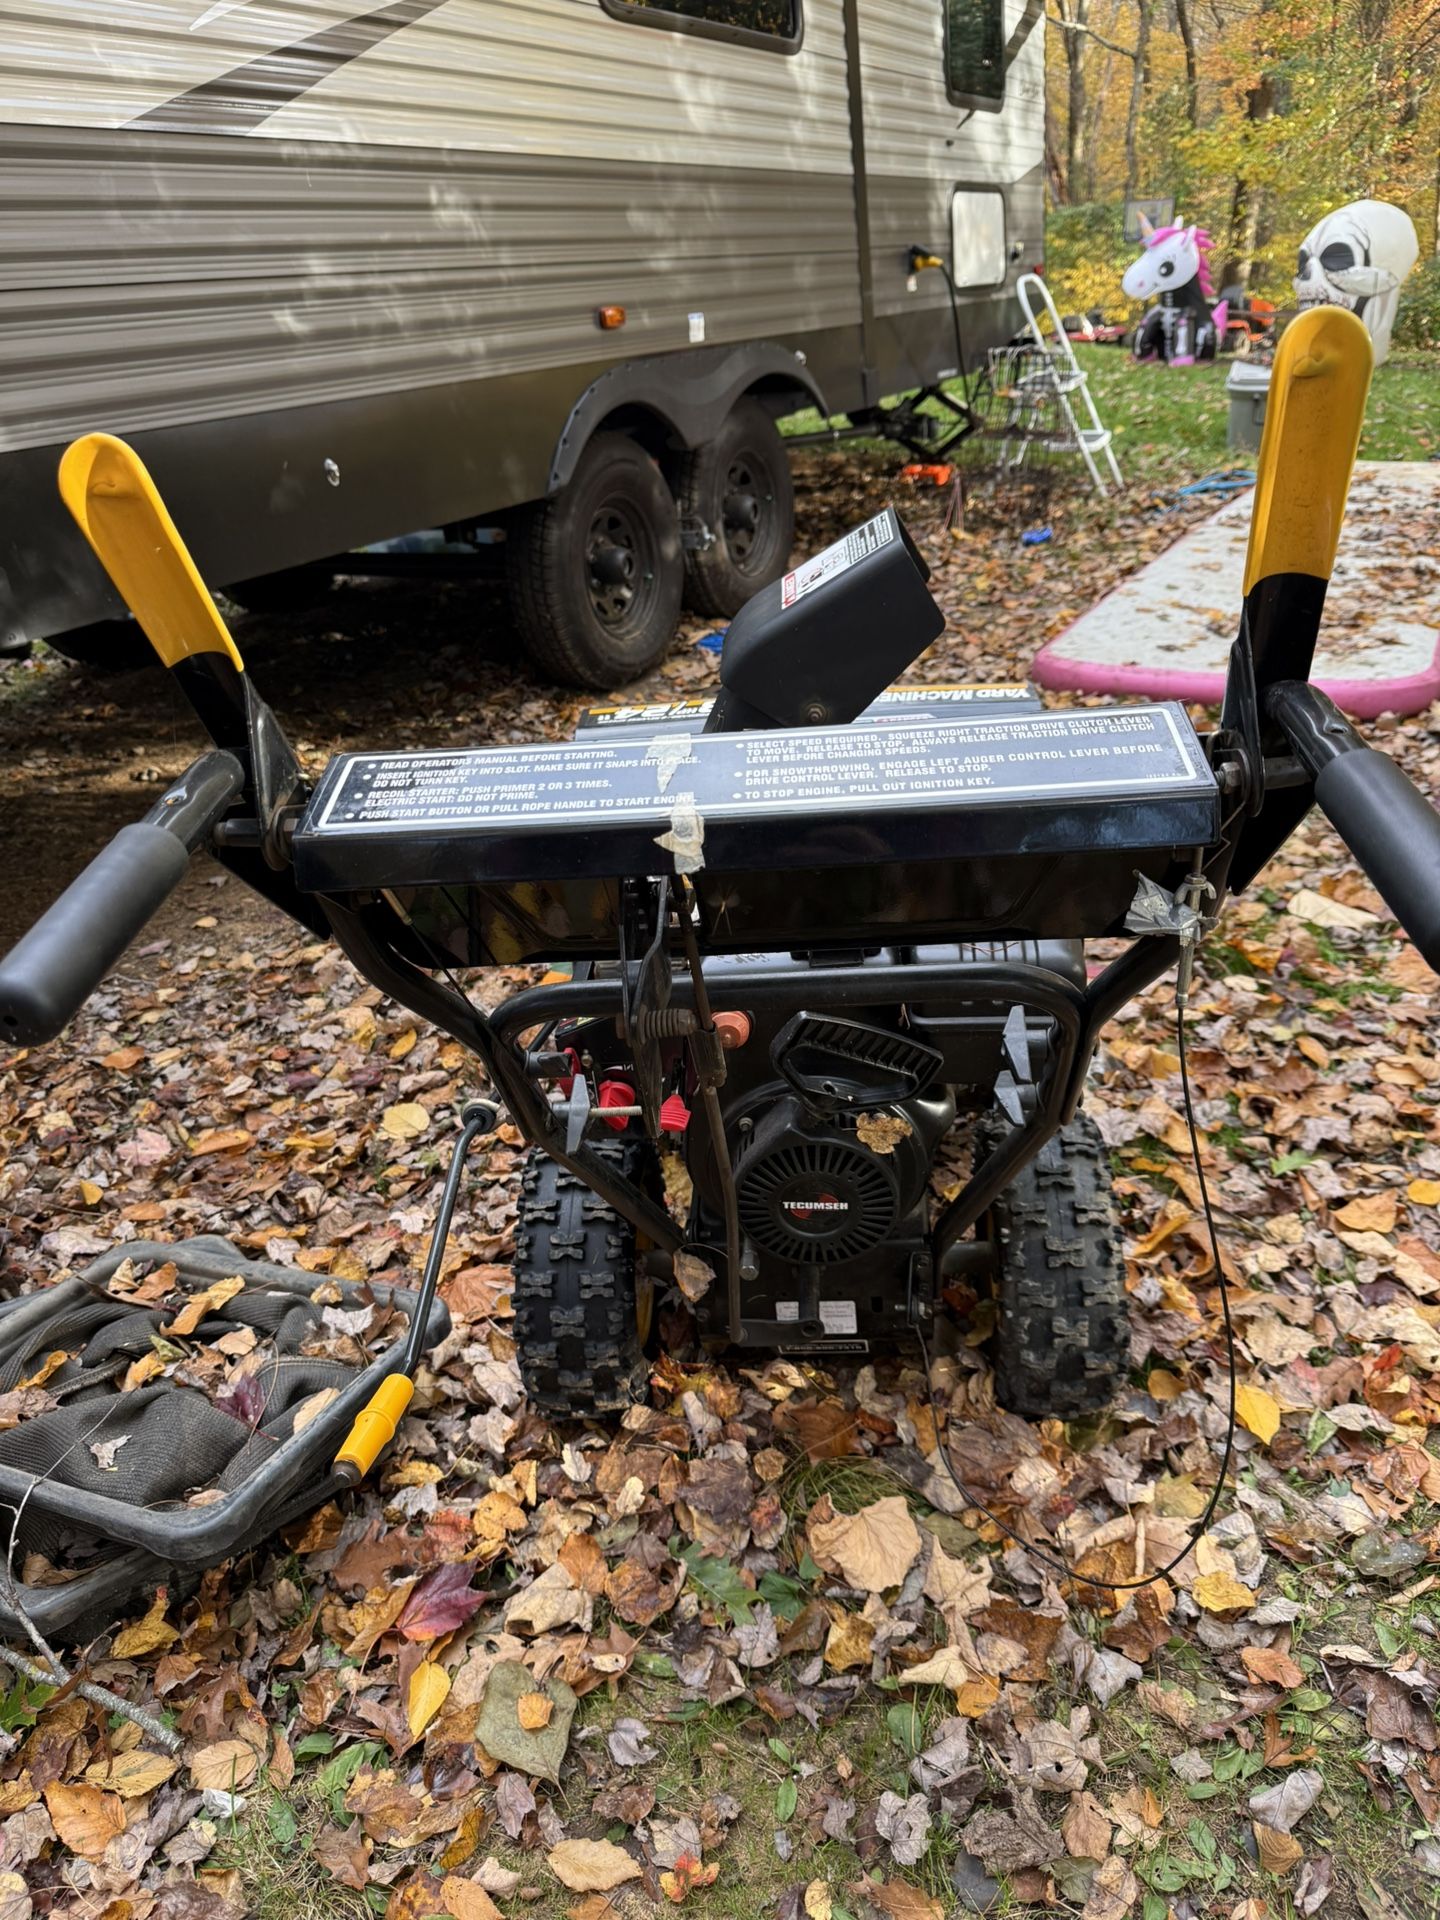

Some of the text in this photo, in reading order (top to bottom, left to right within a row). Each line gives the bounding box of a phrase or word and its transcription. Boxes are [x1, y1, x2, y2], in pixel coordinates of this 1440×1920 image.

[976, 688, 1031, 699] YARD
[747, 716, 1150, 749] SELECT SPEED REQUIRED. SQUEEZE RIGHT TRACTION DRIVE CLUTCH LEVER
[764, 746, 799, 755] MOVE.
[806, 743, 853, 752] RELEASE
[873, 740, 905, 748] STOP.
[911, 736, 955, 745] ALWAYS
[959, 733, 1008, 742] RELEASE
[1011, 729, 1068, 739] TRACTION
[1071, 726, 1106, 735] DRIVE
[1109, 723, 1155, 732] CLUTCH
[380, 761, 409, 769] READ
[474, 755, 518, 764] MANUAL
[521, 753, 561, 762] BEFORE
[564, 750, 617, 760] STARTING.
[746, 746, 931, 763] LEVER BEFORE CHANGING SPEEDS.
[746, 769, 768, 778] FOR
[879, 759, 927, 769] ENGAGE
[930, 757, 959, 766] LEFT
[963, 754, 1005, 764] AUGER
[1008, 750, 1066, 761] CONTROL
[1069, 747, 1110, 757] LEVER
[1112, 744, 1164, 754] BEFORE
[375, 771, 411, 780] INSERT
[413, 769, 459, 778] IGNITION
[458, 768, 478, 776] KEY
[478, 767, 504, 775] INTO
[504, 765, 532, 773] SLOT.
[534, 764, 563, 772] MAKE
[565, 762, 591, 770] SURE
[605, 760, 638, 768] SNAPS
[641, 758, 662, 766] INTO
[665, 756, 701, 765] ACE.
[746, 763, 991, 786] DRIVE CONTROL LEVER. RELEASE TO STOP.
[368, 790, 406, 798] RECOIL
[408, 787, 459, 797] STARTER:
[461, 786, 491, 794] PUSH
[492, 784, 535, 792] PRIMER
[547, 782, 563, 790] OR
[575, 780, 612, 789] TIMES.
[445, 776, 468, 784] KEY.
[745, 791, 760, 799] TO
[764, 789, 793, 798] STOP
[849, 784, 879, 793] PULL
[882, 782, 907, 791] OUT
[910, 779, 963, 789] IGNITION
[967, 777, 994, 786] KEY.
[359, 810, 389, 819] PUSH
[389, 808, 426, 817] START
[427, 806, 472, 816] BUTTON
[474, 805, 490, 813] OR
[491, 804, 519, 812] PULL
[521, 802, 552, 811] ROPE
[553, 799, 596, 809] HANDLE
[616, 797, 651, 806] START
[364, 797, 416, 806] ELECTRIC
[417, 795, 455, 804] START:
[499, 791, 538, 800] PRIME.
[782, 1201, 849, 1210] TECUMSEH
